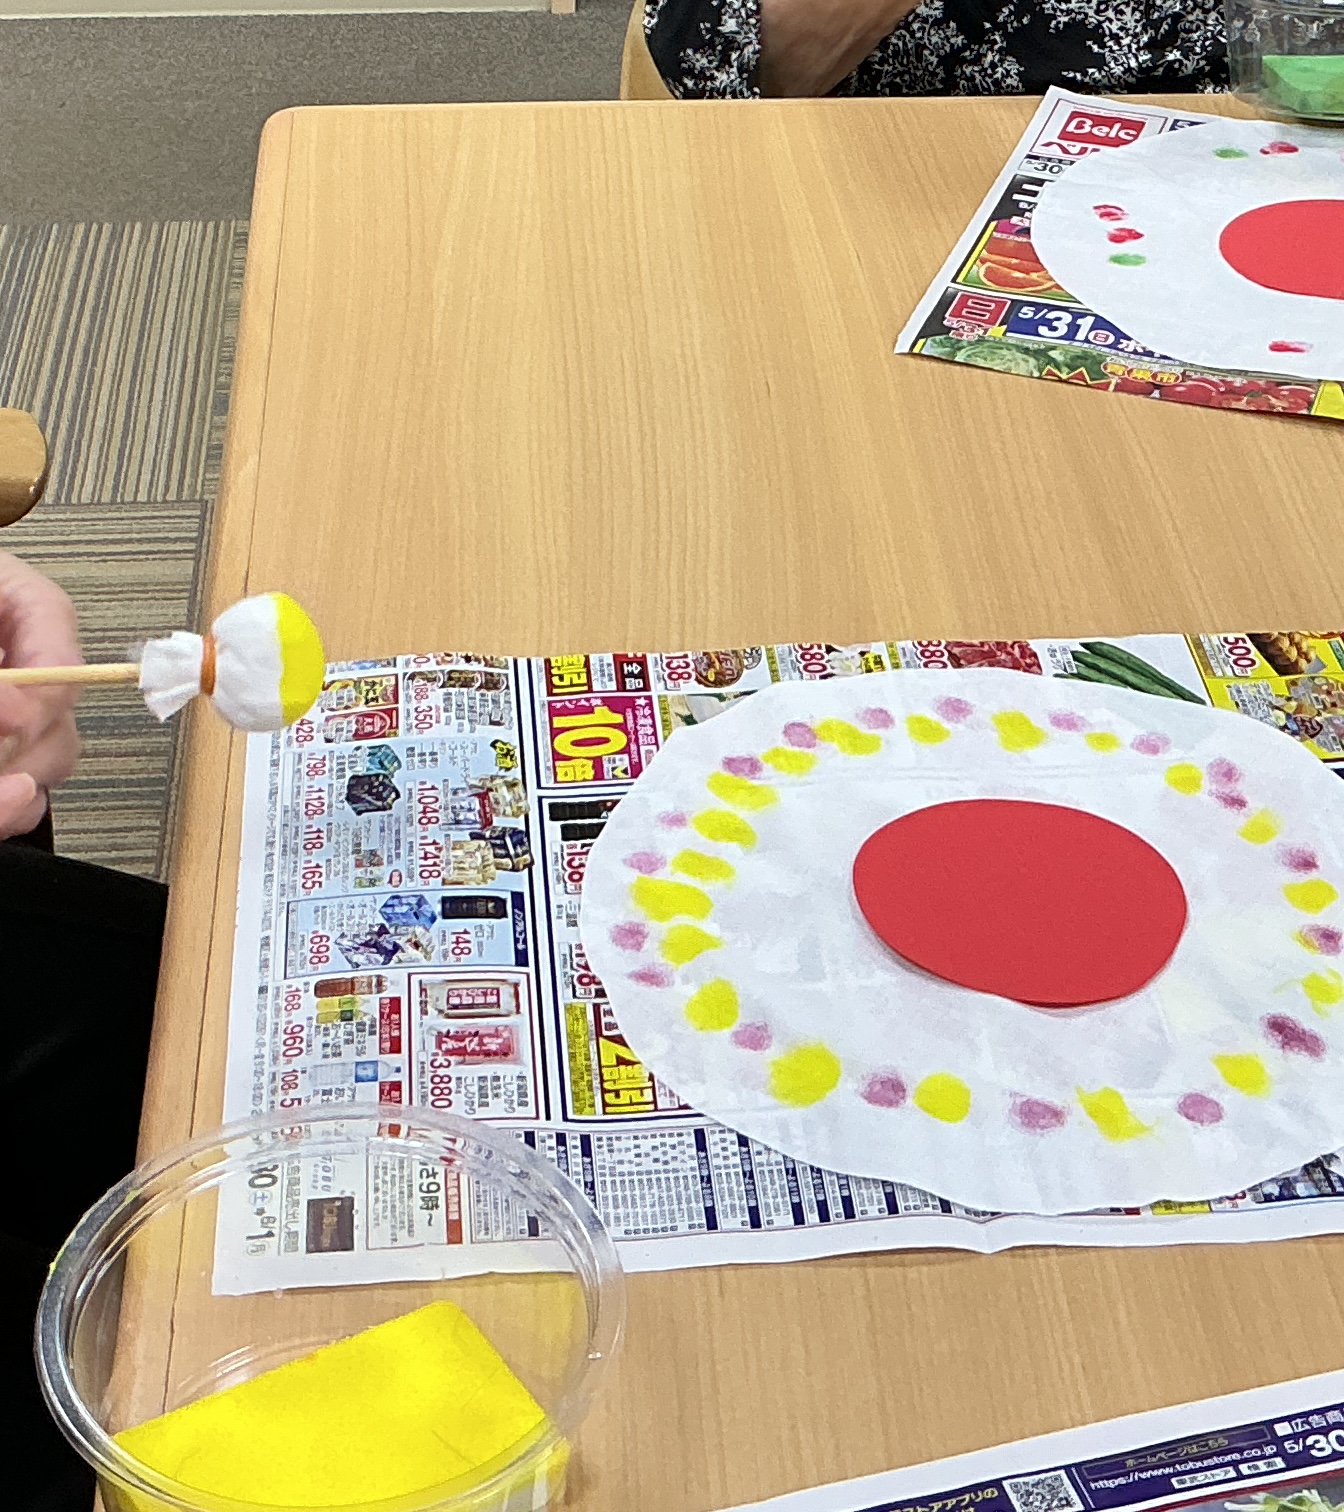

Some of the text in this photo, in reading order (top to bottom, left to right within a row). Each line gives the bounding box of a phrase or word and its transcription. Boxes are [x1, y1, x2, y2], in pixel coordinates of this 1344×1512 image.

[1064, 117, 1139, 141] Belc
[1017, 306, 1098, 340] 5/31
[550, 654, 588, 693] 割引
[623, 662, 644, 690] 全品
